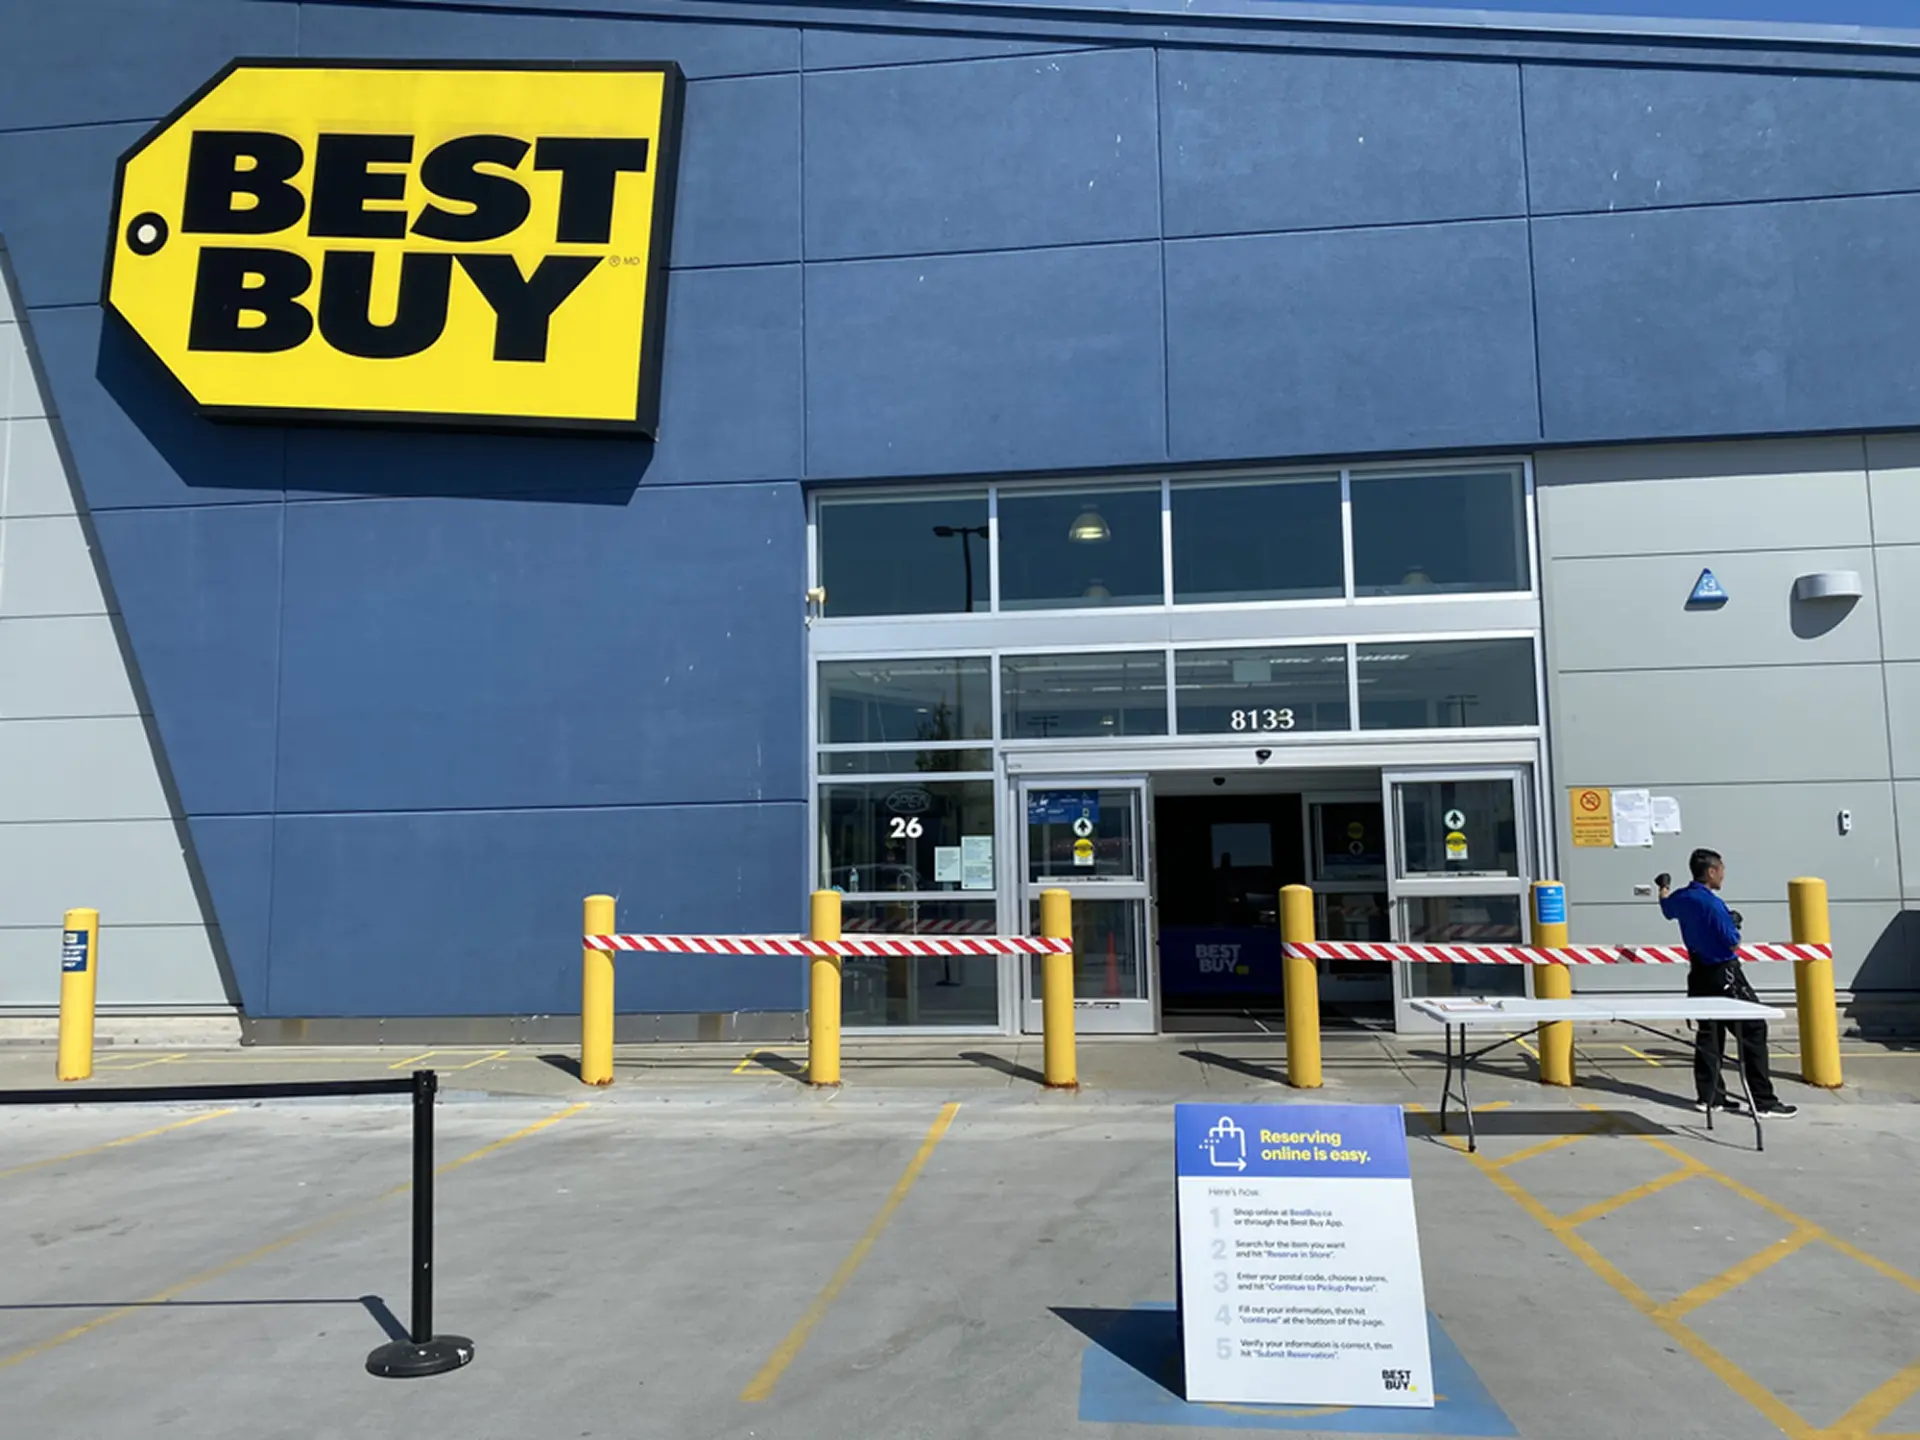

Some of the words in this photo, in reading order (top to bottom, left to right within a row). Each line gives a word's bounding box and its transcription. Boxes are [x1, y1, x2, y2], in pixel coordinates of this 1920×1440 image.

[181, 129, 649, 243] BEST
[187, 246, 605, 362] BUY
[1231, 708, 1295, 731] 8133
[890, 817, 923, 838] 26
[1195, 944, 1241, 958] BEST
[1200, 959, 1235, 973] BUY
[1260, 1129, 1341, 1147] Reserving
[1261, 1147, 1311, 1161] online
[1314, 1147, 1327, 1161] is
[1330, 1149, 1371, 1165] easy.
[1210, 1207, 1220, 1228] 1
[1233, 1208, 1254, 1217] Shop
[1255, 1208, 1279, 1216] online
[1244, 1219, 1274, 1227] through
[1309, 1219, 1324, 1227] Buy
[1211, 1239, 1227, 1260] 2
[1213, 1271, 1229, 1293] 3
[1279, 1274, 1301, 1282] postal
[1317, 1284, 1344, 1292] Pickup
[1215, 1304, 1232, 1327] 4
[1306, 1317, 1336, 1325] bottom
[1216, 1337, 1232, 1360] 5
[1240, 1340, 1263, 1348] Verify
[1285, 1340, 1332, 1349] information
[1382, 1369, 1411, 1380] BEST
[1385, 1379, 1409, 1391] BUY
